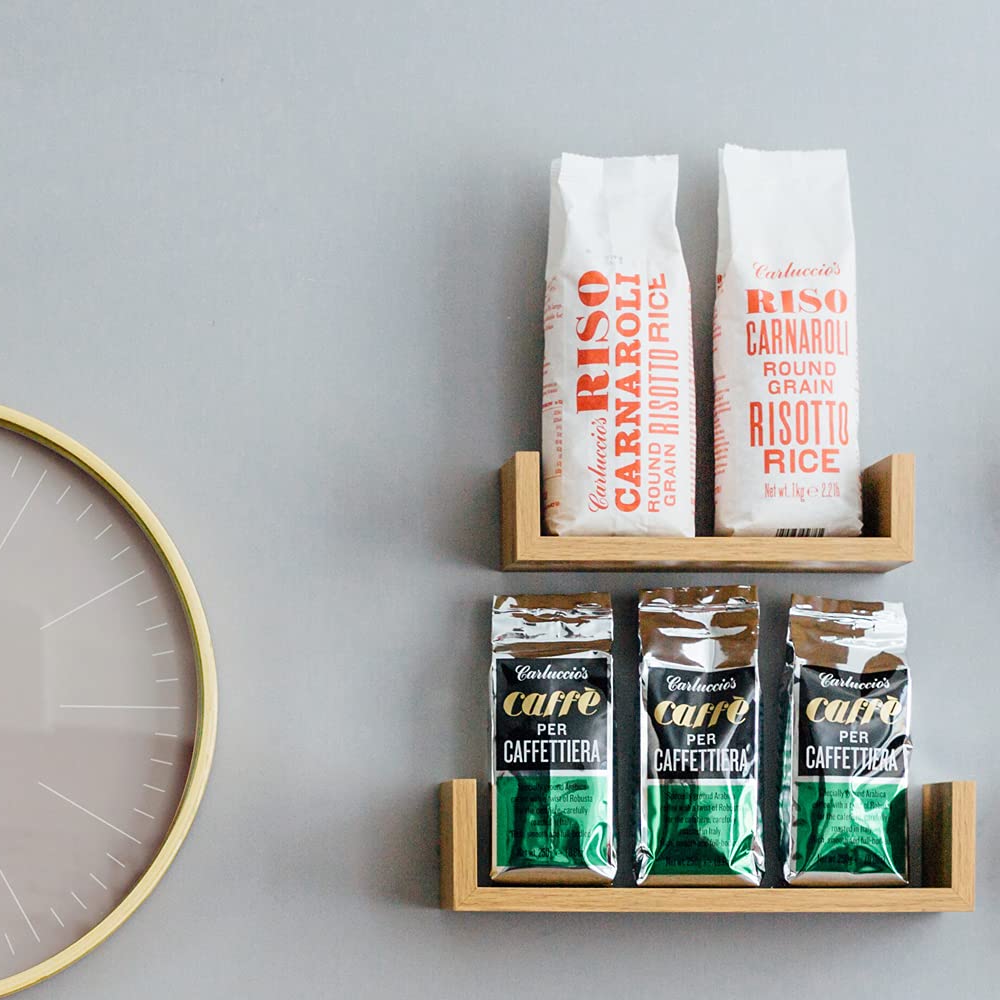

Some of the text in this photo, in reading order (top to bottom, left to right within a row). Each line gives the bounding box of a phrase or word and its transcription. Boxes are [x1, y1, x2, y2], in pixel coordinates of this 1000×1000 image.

[752, 261, 841, 280] Carluccio's
[745, 288, 848, 315] RISO
[746, 318, 848, 356] CARNAROLI
[648, 273, 679, 434] RISOTTO RICE
[763, 361, 836, 376] ROUND
[576, 270, 610, 513] Carluccio's RISO
[615, 273, 641, 512] CARNAROLI
[768, 379, 833, 394] GRAIN
[749, 400, 849, 447] RISOTTO
[763, 448, 840, 474] RICE
[648, 442, 661, 512] ROUND
[664, 444, 676, 507] GRAIN
[764, 483, 776, 498] Net
[515, 664, 588, 681] Carluccio's
[666, 675, 737, 692] Carluccio's
[819, 672, 890, 689] Carluccio's
[503, 686, 601, 718] caffè
[654, 696, 749, 728] caffè
[806, 695, 902, 725] caffè
[537, 723, 567, 736] PER
[686, 733, 716, 745] PER
[839, 730, 869, 743] PER
[503, 739, 600, 763] CAFFETTIERA
[654, 748, 747, 772] CAFFETTIERA
[806, 746, 898, 771] CAFFETTIERA
